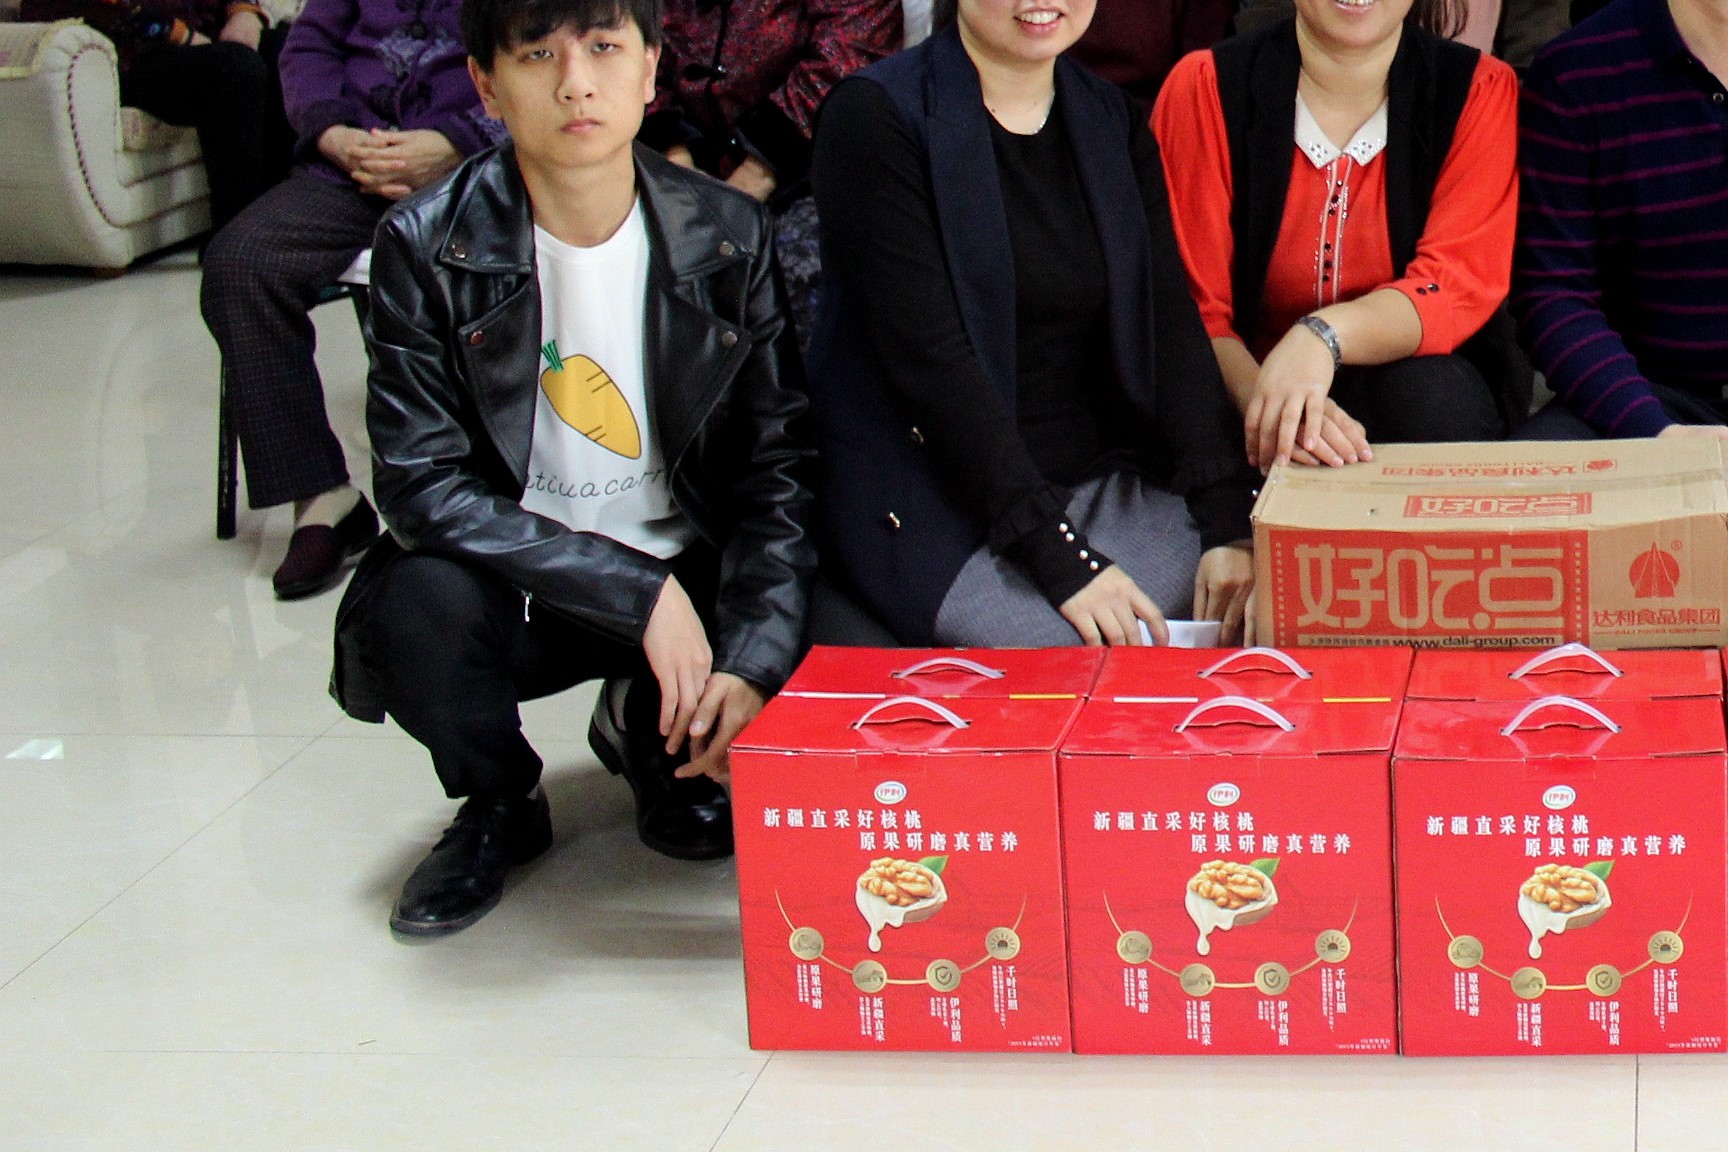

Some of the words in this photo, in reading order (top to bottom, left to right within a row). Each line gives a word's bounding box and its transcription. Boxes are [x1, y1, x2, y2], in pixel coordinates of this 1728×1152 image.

[1294, 543, 1564, 630] 好吃点
[1592, 608, 1721, 628] 达利食品集团
[763, 808, 922, 831] 新疆直采好核桃
[1093, 811, 1255, 833] 新疆直采好核桃
[1426, 815, 1589, 837] 新疆直采好核桃
[860, 832, 1018, 853] 原果研磨真营养
[1191, 834, 1351, 856] 原果研磨真营养
[1524, 833, 1686, 859] 原果研磨真营养
